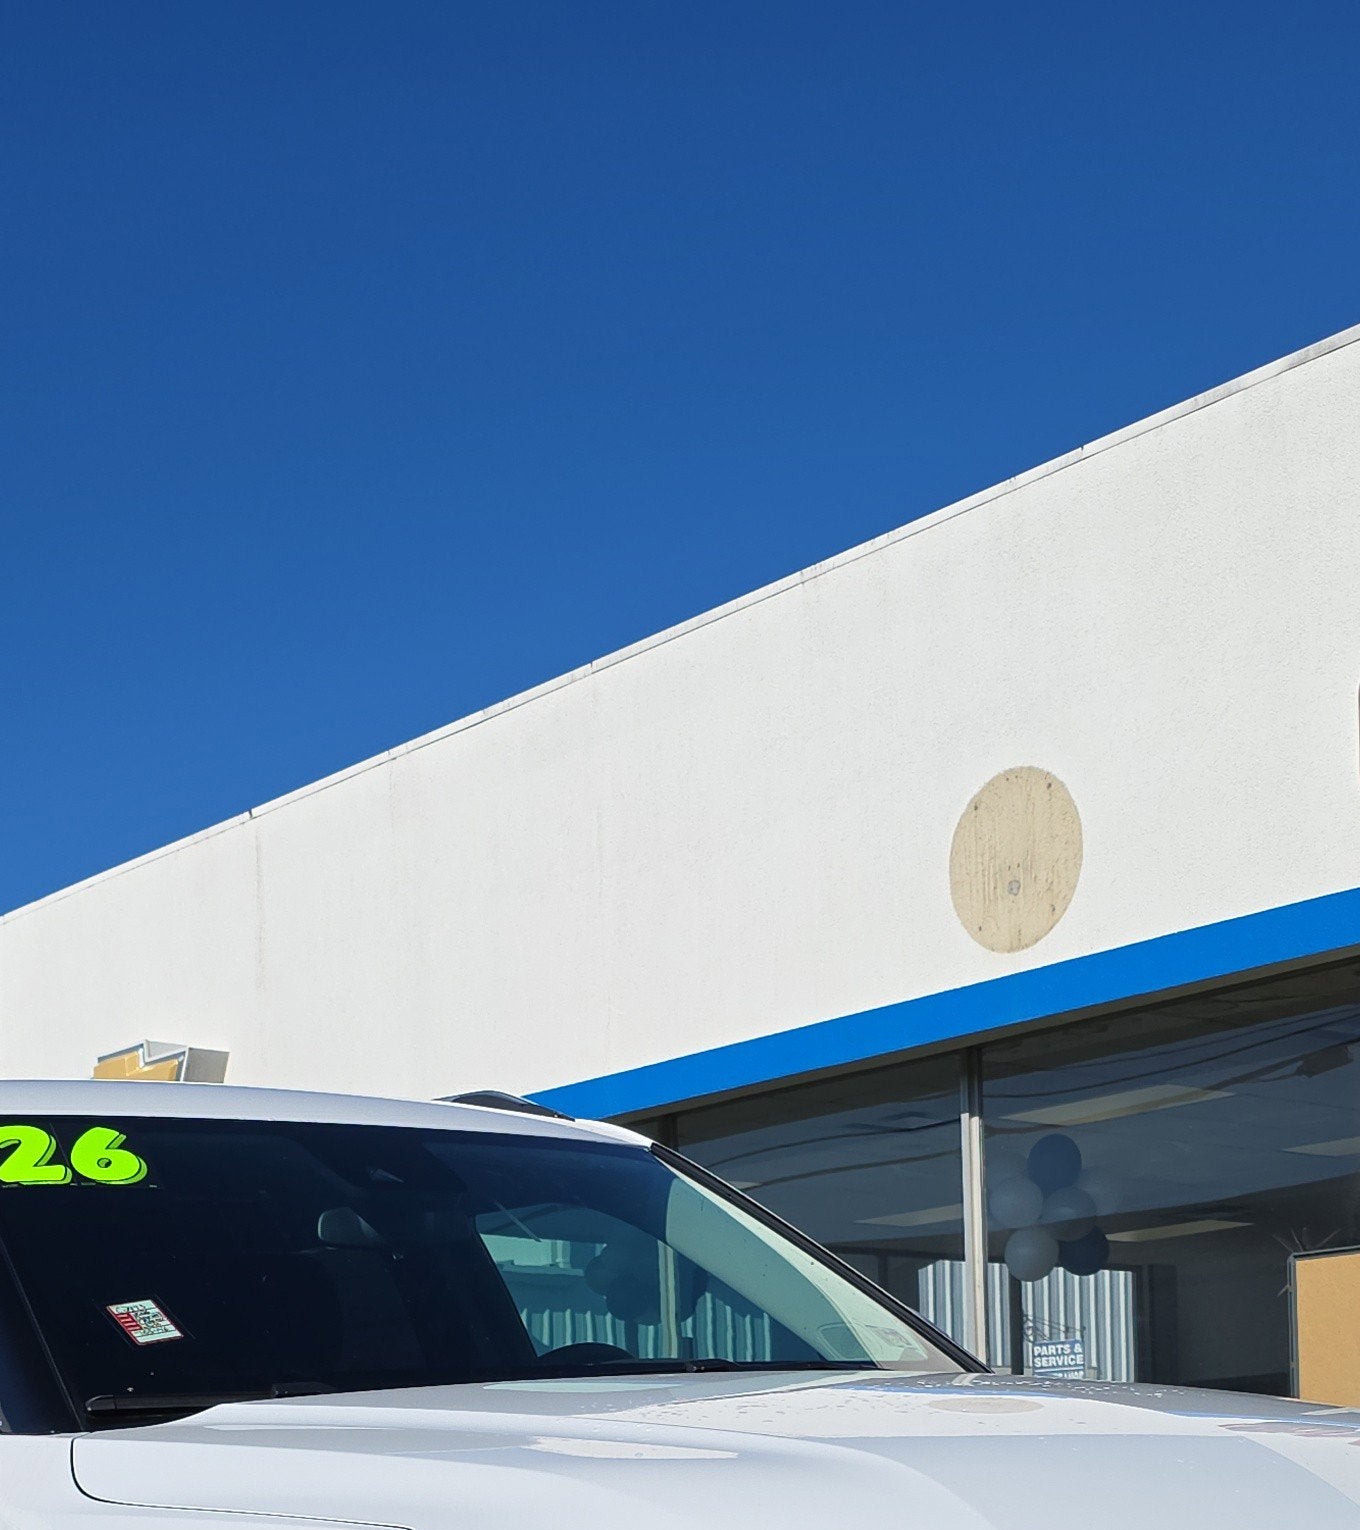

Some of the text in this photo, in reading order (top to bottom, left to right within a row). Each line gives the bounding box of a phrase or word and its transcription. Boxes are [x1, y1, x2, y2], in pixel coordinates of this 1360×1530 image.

[1033, 1342, 1083, 1356] PARTS &
[1033, 1354, 1084, 1368] SERVICE
